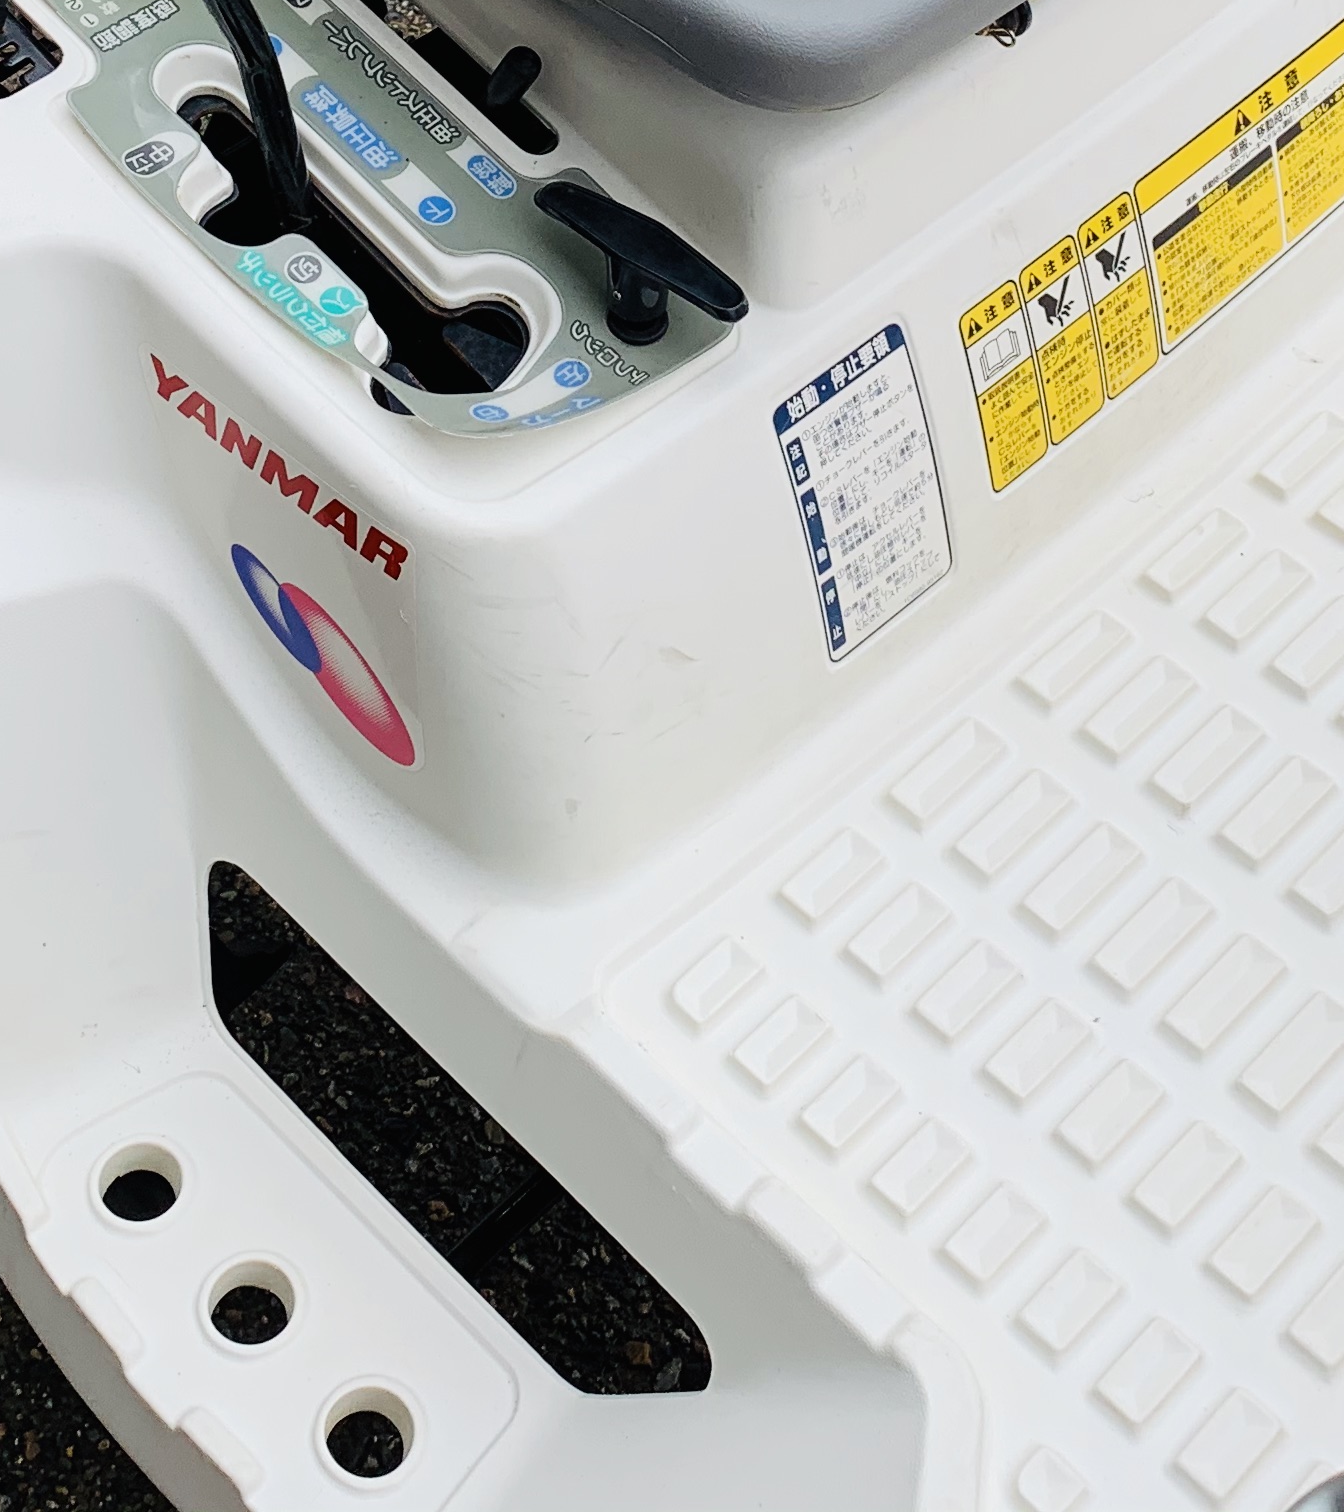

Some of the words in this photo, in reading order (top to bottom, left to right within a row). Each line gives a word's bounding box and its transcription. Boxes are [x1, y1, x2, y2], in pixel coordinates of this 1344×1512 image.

[323, 20, 462, 144] 油圧ストップレバー
[1257, 65, 1300, 115] 注意
[302, 83, 400, 170] 油圧昇降
[125, 144, 173, 174] 中立
[468, 156, 515, 196] 解除
[423, 198, 451, 222] 下
[1099, 200, 1130, 235] 注意
[289, 256, 319, 282] 切
[1042, 243, 1074, 279] 注意
[238, 251, 347, 346] 植付クラッチ
[321, 288, 351, 312] 入
[983, 287, 1015, 324] 注意
[556, 362, 588, 386] 左
[785, 328, 891, 424] 始動・停止要領
[150, 353, 410, 581] YANMAR
